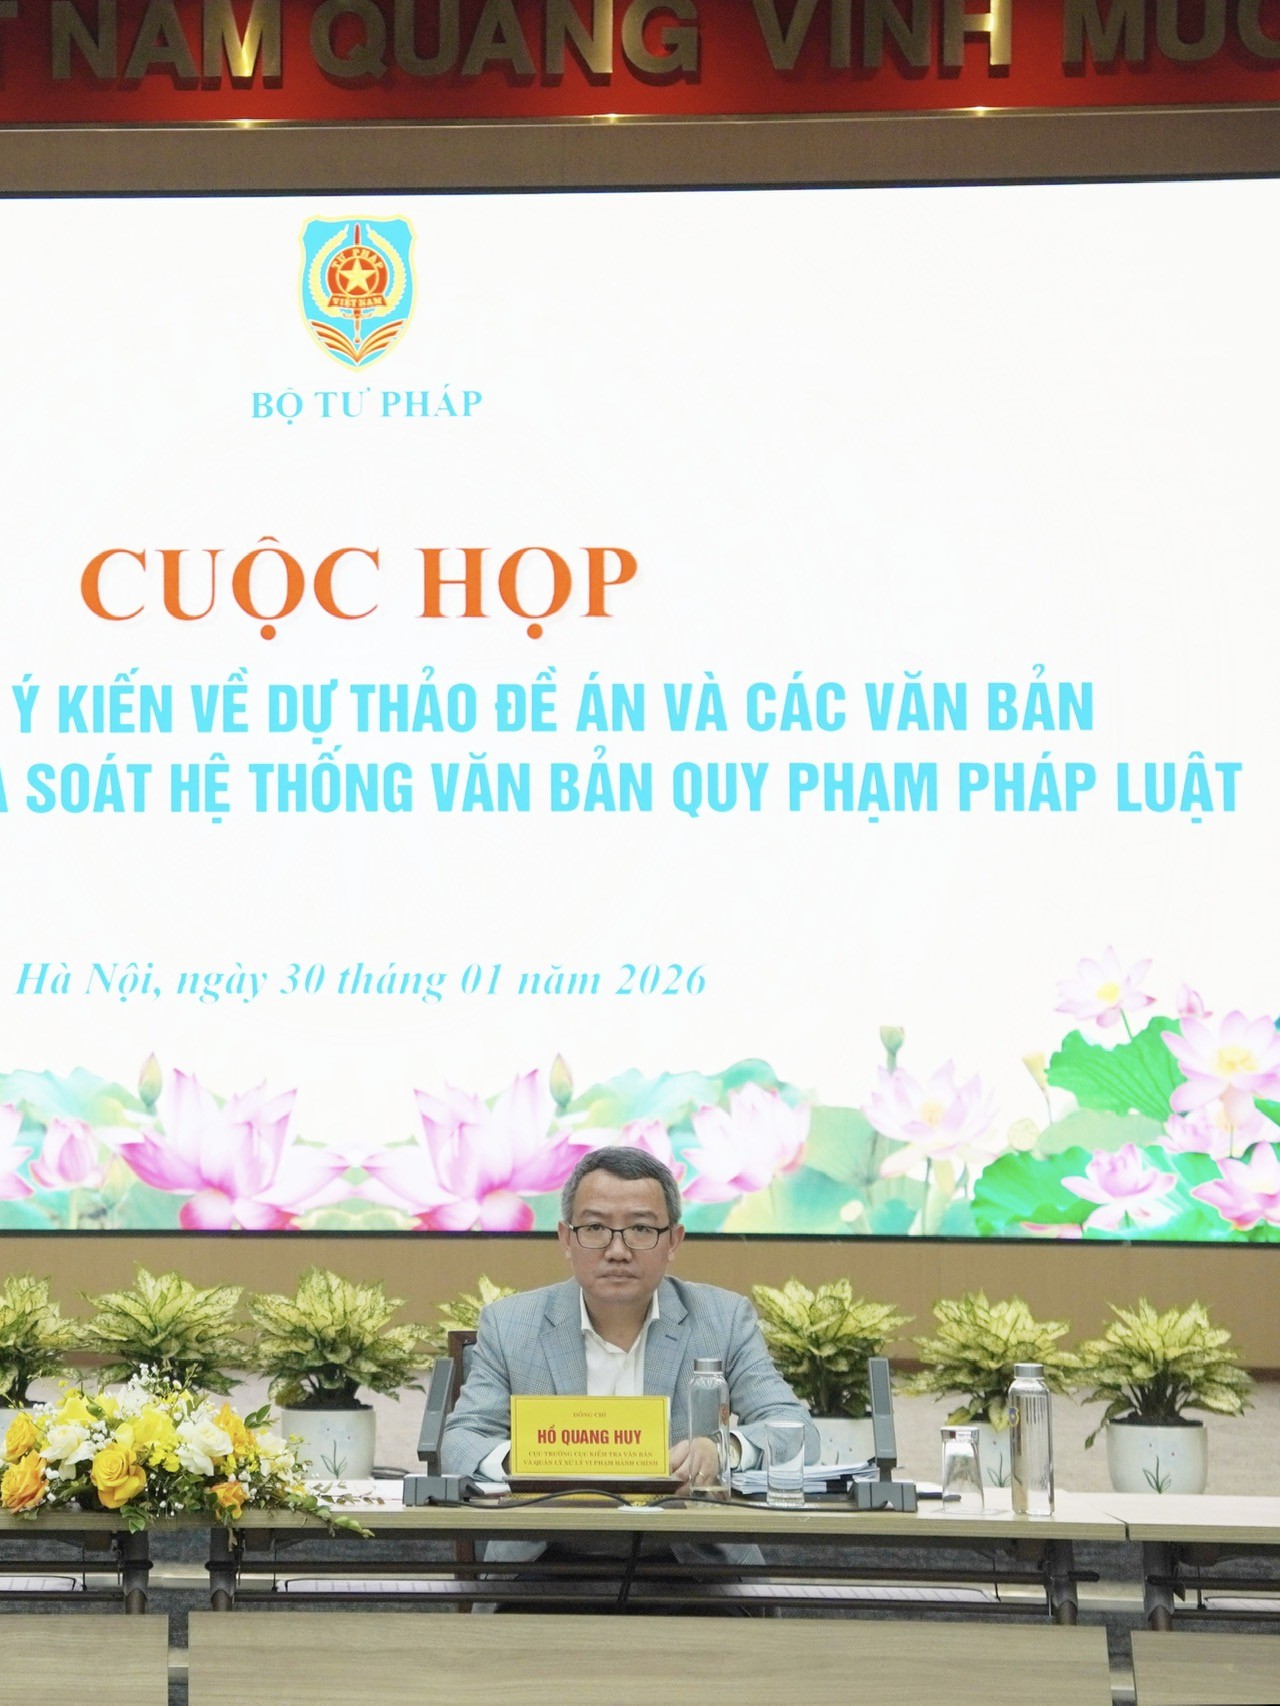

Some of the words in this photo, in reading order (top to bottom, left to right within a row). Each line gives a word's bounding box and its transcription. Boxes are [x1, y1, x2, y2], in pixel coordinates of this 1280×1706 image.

[309, 0, 699, 79] QUANG
[752, 0, 1010, 72] VINH
[252, 387, 303, 425] BỘ
[314, 386, 371, 417] TƯ
[381, 383, 483, 417] PHÁP
[80, 535, 380, 641] CUỘC
[414, 546, 638, 640] HỌP
[12, 674, 40, 733] Ý
[59, 667, 172, 733] KIẾN
[191, 667, 249, 733] VỀ
[269, 679, 338, 744] DỰ
[350, 666, 477, 732] THẢO
[495, 666, 557, 732] ĐỀ
[576, 672, 645, 731] ÁN
[664, 671, 728, 731] VÀ
[746, 671, 846, 732] CÁC
[865, 671, 967, 731] VĂN
[988, 664, 1093, 731] BẢN
[27, 753, 152, 813] SOÁT
[171, 753, 230, 824] HỆ
[249, 745, 413, 813] THỐNG
[431, 751, 531, 812] VĂN
[551, 745, 652, 812] BẢN
[673, 761, 769, 818] QUY
[789, 762, 937, 823] PHẠM
[959, 751, 1096, 812] PHÁP
[1117, 751, 1242, 823] LUẬT
[16, 962, 71, 994] Hà
[85, 962, 161, 1003] Nội,
[177, 963, 267, 1003] ngày
[280, 963, 325, 994] 30
[337, 963, 446, 1003] tháng
[461, 964, 502, 995] 01
[518, 964, 600, 995] năm
[615, 964, 706, 995] 2026
[561, 1429, 609, 1445] QUANG
[614, 1430, 642, 1444] HUY
